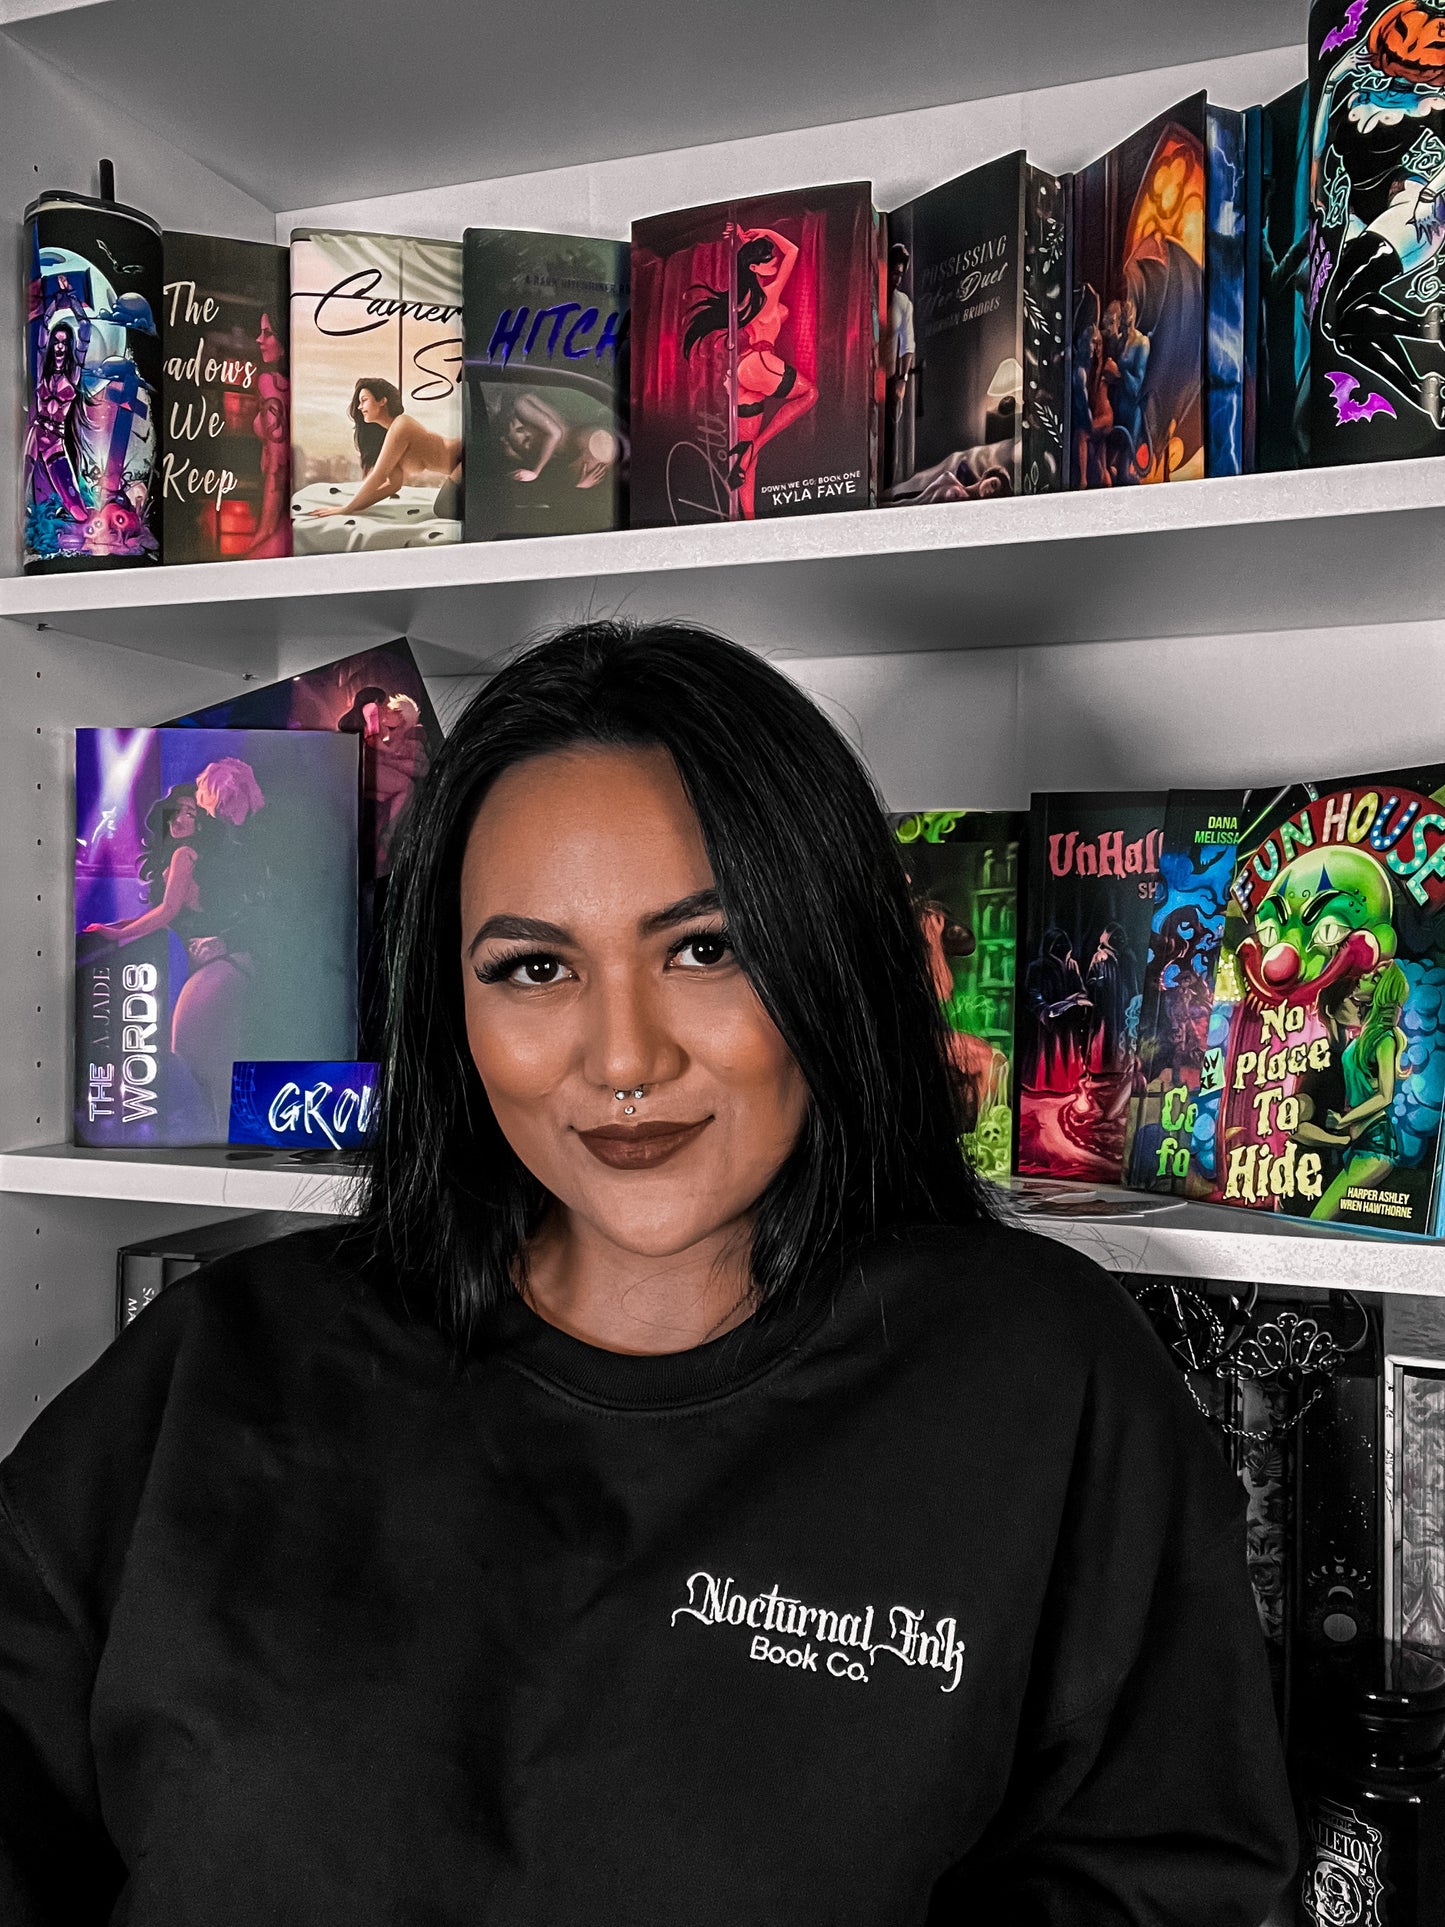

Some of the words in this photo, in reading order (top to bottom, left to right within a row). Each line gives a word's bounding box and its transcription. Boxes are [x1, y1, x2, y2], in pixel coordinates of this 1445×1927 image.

[163, 280, 220, 328] The
[163, 337, 257, 389] adows
[170, 395, 225, 441] We
[163, 452, 238, 512] Keep
[761, 484, 787, 494] DOWN
[787, 480, 801, 489] WE
[818, 475, 841, 484] BOOK
[843, 470, 861, 480] ONE
[772, 488, 812, 506] KYLA
[817, 480, 856, 498] FAYE
[1194, 830, 1240, 844] MELISSA
[1207, 816, 1237, 830] DANA
[1231, 810, 1314, 912] FUN
[120, 962, 158, 1123] WORDS
[1260, 999, 1305, 1044] No
[1232, 1037, 1331, 1093] Place
[88, 1062, 115, 1122] THE
[1253, 1087, 1300, 1138] To
[1223, 1140, 1323, 1205] Hide
[1347, 1186, 1379, 1202] HARPER
[1379, 1190, 1411, 1206] ASHLEY
[1339, 1198, 1363, 1212] WREN
[1362, 1201, 1414, 1219] HAWTHORNE
[671, 1571, 875, 1651] Nocturnal
[870, 1605, 966, 1692] Ink
[750, 1634, 818, 1672] Book
[825, 1651, 870, 1683] Co.
[1309, 1820, 1374, 1870] ELETON
